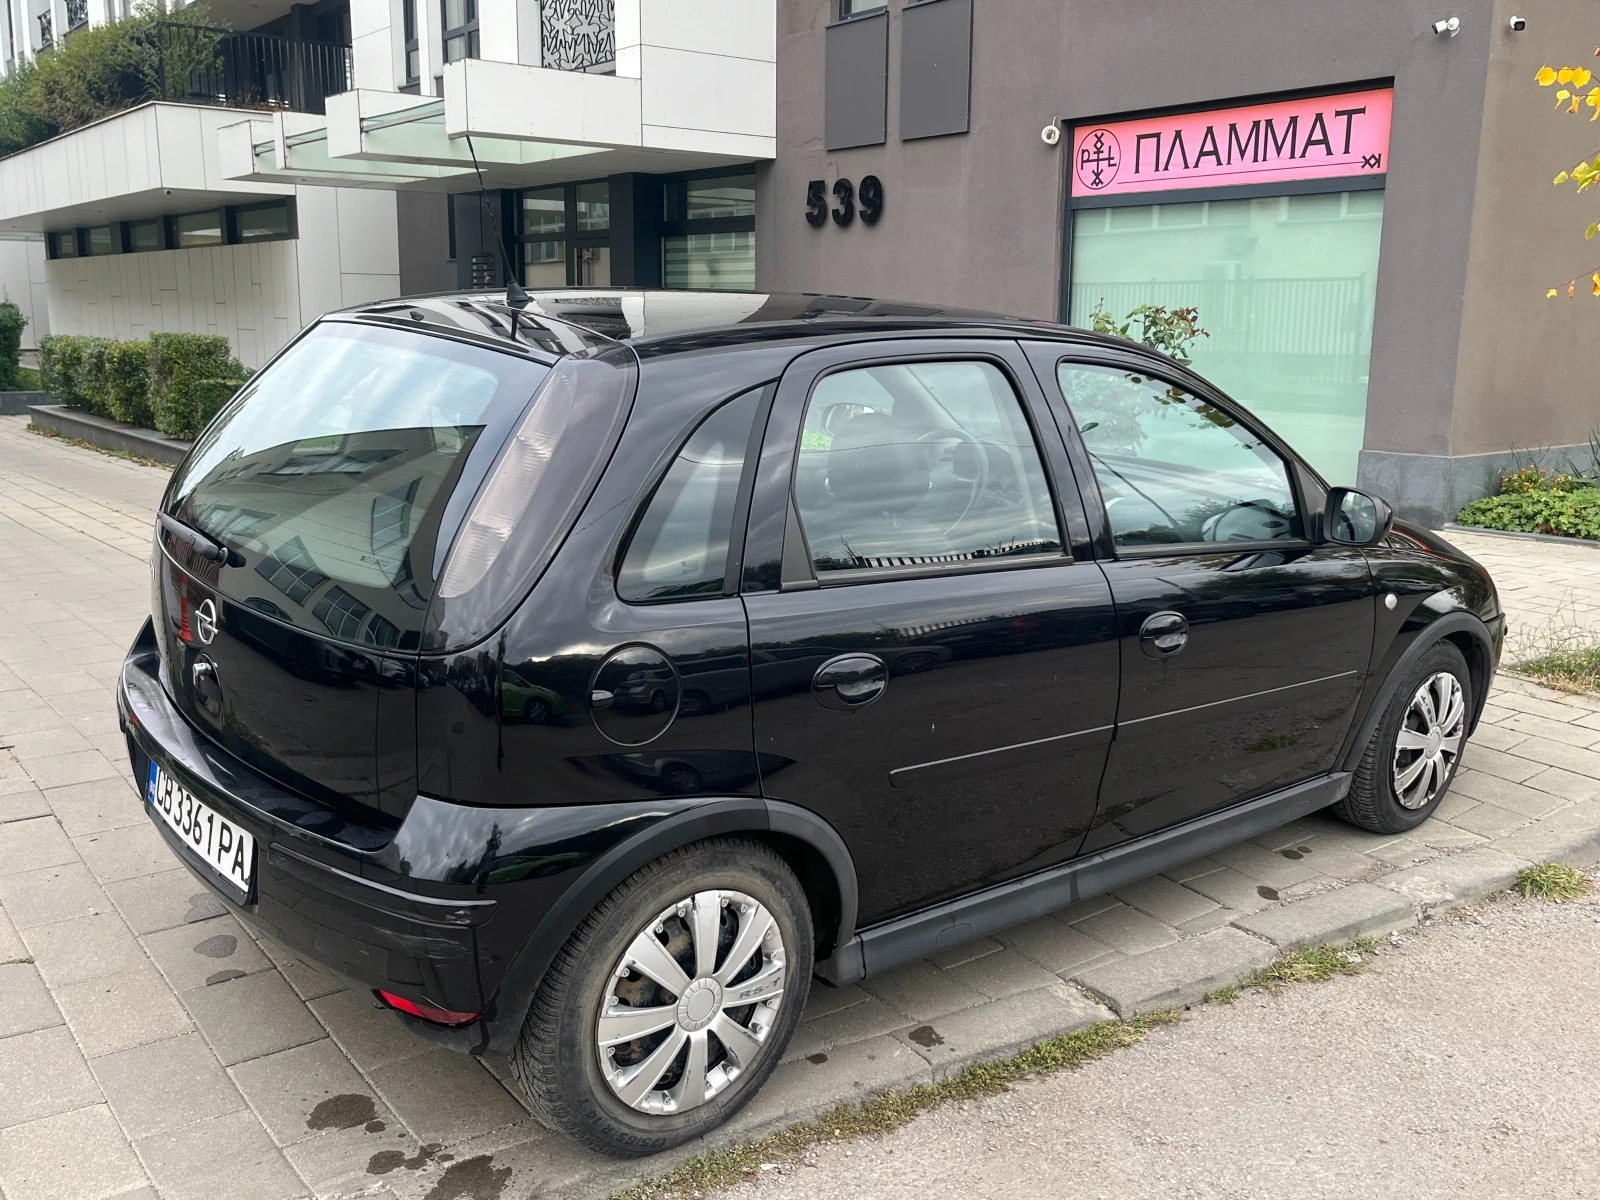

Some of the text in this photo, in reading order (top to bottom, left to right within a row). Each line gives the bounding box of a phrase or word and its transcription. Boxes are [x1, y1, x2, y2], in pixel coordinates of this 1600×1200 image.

[1134, 106, 1366, 174] ПЛАММАТ
[805, 175, 883, 229] 539
[739, 977, 781, 999] RS-T
